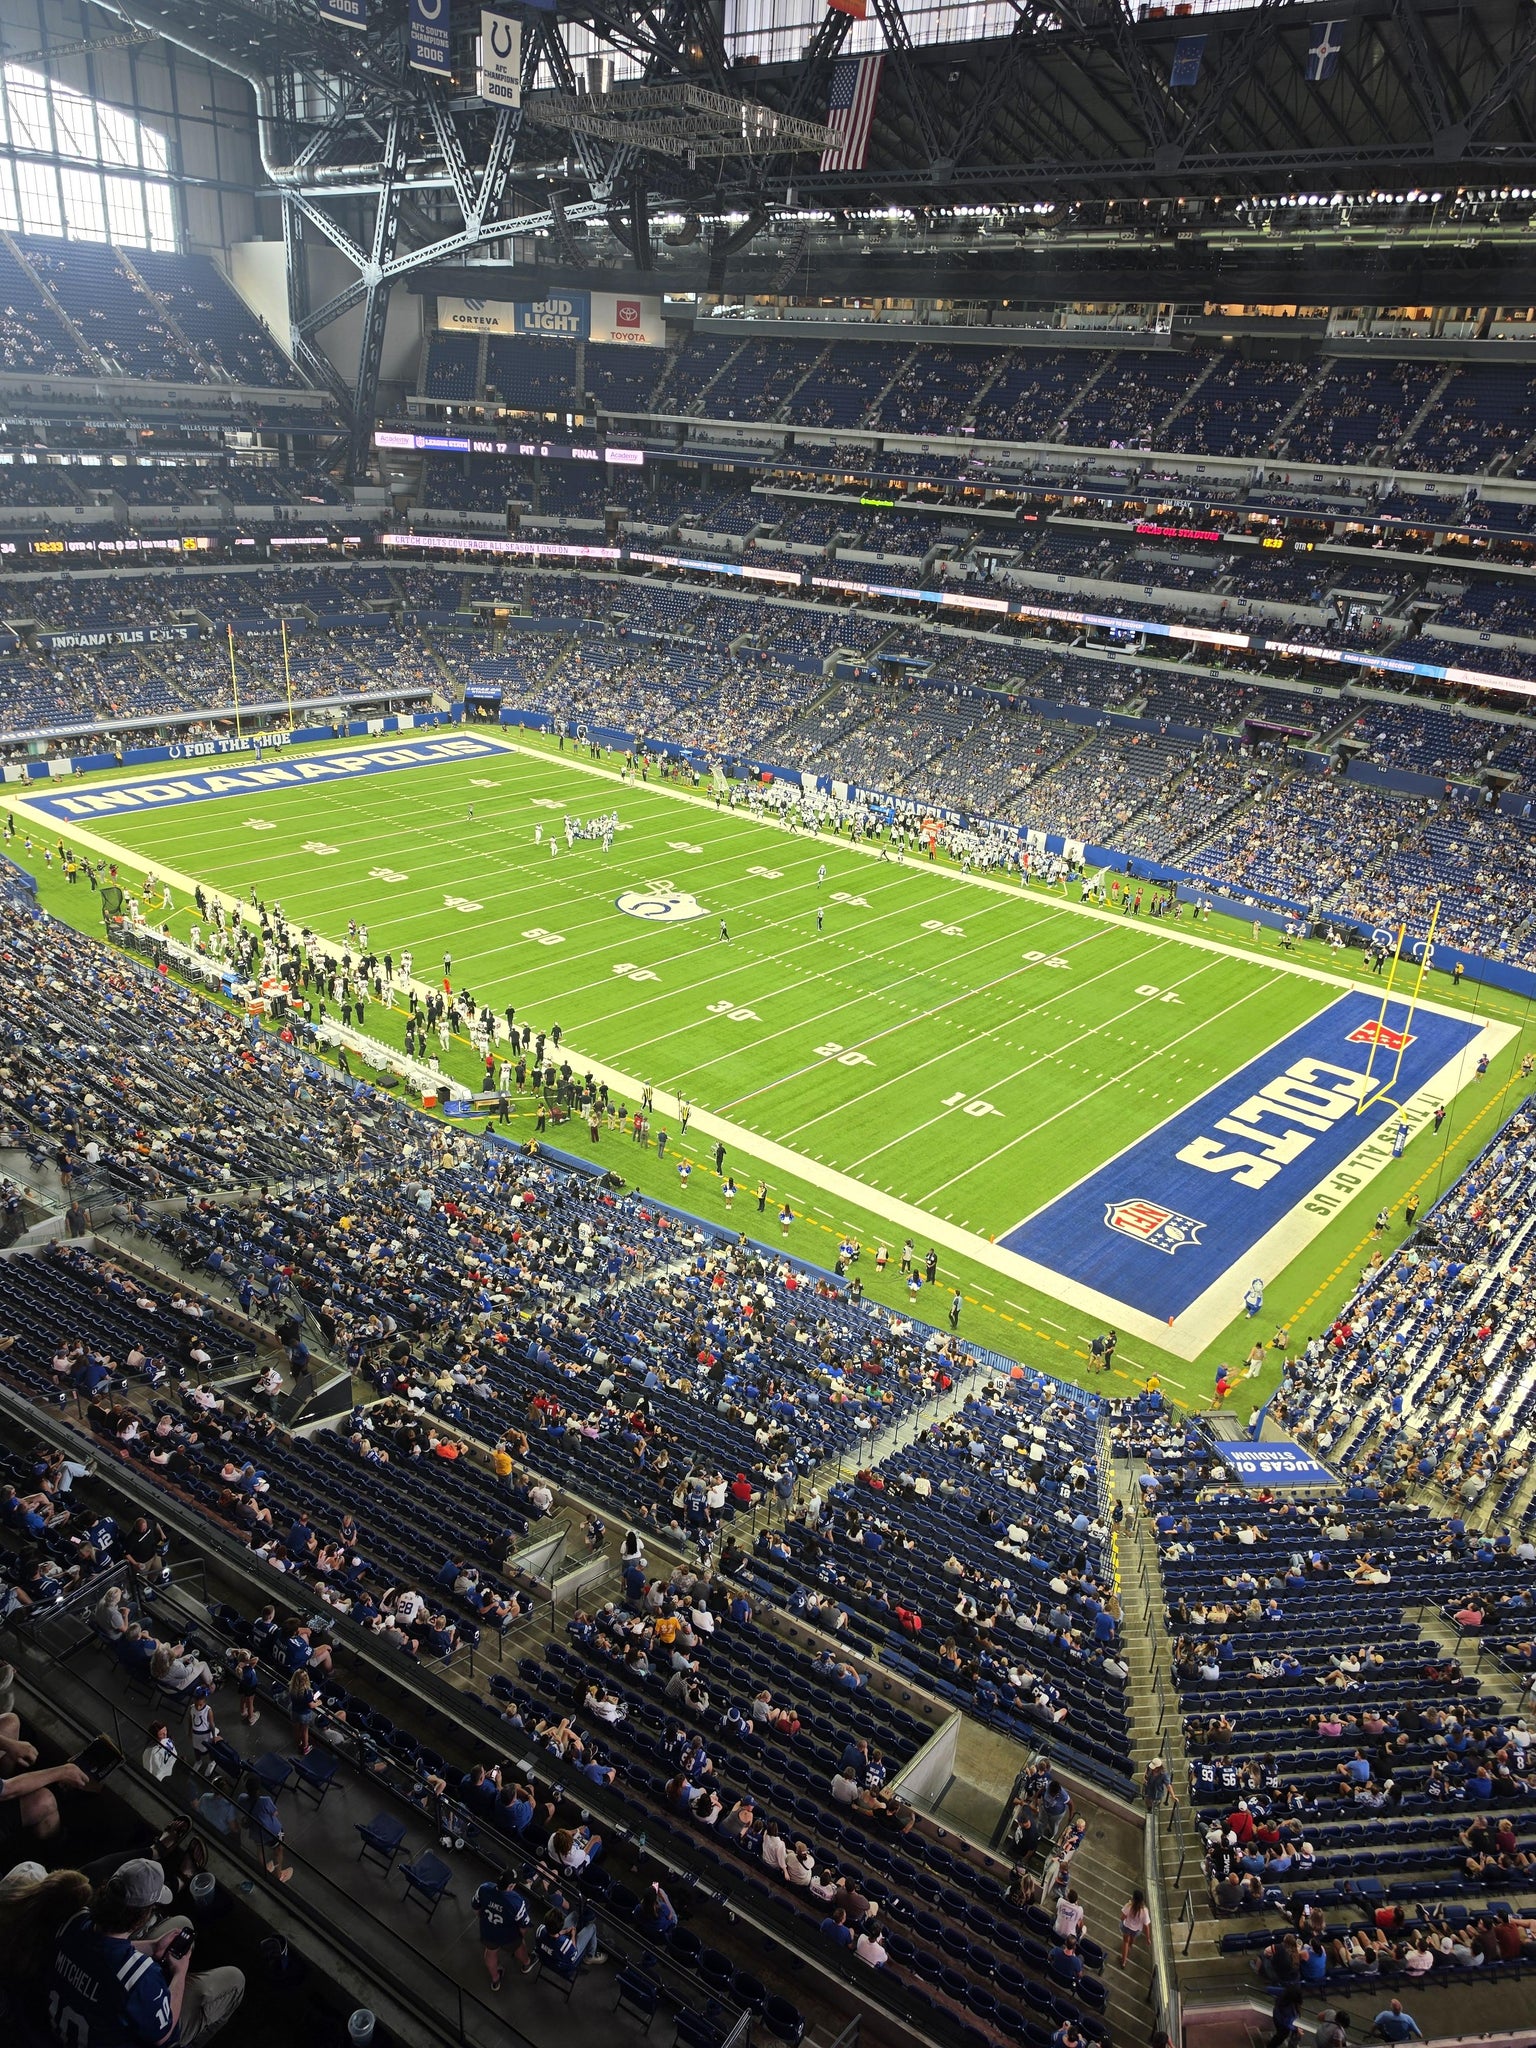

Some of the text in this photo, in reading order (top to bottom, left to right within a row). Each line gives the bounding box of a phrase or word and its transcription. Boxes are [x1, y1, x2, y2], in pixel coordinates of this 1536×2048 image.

[329, 0, 359, 15] 2005
[412, 21, 449, 39] AFC SOUTH
[411, 30, 449, 49] CHAMPIONS
[416, 45, 444, 63] 2006
[495, 64, 507, 73] AFC
[484, 69, 519, 86] CHAMPIONS
[488, 83, 513, 99] 2006
[532, 300, 572, 316] BUD
[452, 314, 499, 326] CORTEVA
[524, 313, 581, 332] LIGHT
[610, 331, 646, 343] TOYOTA
[107, 421, 127, 429] WAYNE
[202, 424, 220, 432] CLARK
[380, 435, 410, 444] Academy
[473, 441, 492, 452] NYJ
[496, 443, 507, 453] 17
[520, 445, 535, 455] PIT
[541, 446, 548, 456] 0
[572, 448, 599, 460] FINAL
[609, 451, 638, 462] Academy
[1136, 525, 1220, 541] LUCAS OIL STADIUM
[395, 536, 421, 545] CATCH
[422, 538, 447, 547] COLTS
[448, 539, 488, 549] COVERAGE
[489, 542, 503, 550] ALL
[505, 543, 535, 552] SEASON
[537, 545, 557, 553] LONG
[558, 546, 569, 554] ON
[1262, 537, 1313, 552] 13:33 QTR 4
[828, 579, 839, 588] GOT
[853, 583, 868, 592] BACK
[1021, 606, 1039, 615] WE'VE
[1040, 608, 1051, 617] GOT
[1052, 609, 1067, 620] YOUR
[1067, 611, 1083, 622] BACK
[1265, 640, 1415, 671] WE'VE GOT YOUR BACK FROM KICKOFF TO RECOVERY
[40, 725, 94, 735] STADIUM
[185, 742, 216, 757] FOR
[219, 738, 250, 752] THE
[54, 738, 493, 815] INDIANAPOLIS
[855, 788, 961, 826] INDIANAPOLIS
[368, 867, 408, 883] 30
[746, 866, 784, 880] 50
[443, 896, 484, 912] 40
[920, 920, 963, 936] 30
[521, 928, 566, 945] 50
[1022, 951, 1069, 968] 20
[612, 963, 656, 982] 40
[1135, 985, 1179, 1003] 10
[706, 1000, 756, 1022] 30
[813, 1042, 867, 1066] 20
[941, 1092, 995, 1117] 10
[1417, 1092, 1444, 1108] IT
[1175, 1057, 1381, 1190] COLTS
[1348, 1144, 1390, 1170] ALL
[1330, 1172, 1362, 1194] OF
[1304, 1193, 1342, 1217] US
[1114, 1203, 1169, 1235] NFL
[1231, 1451, 1297, 1461] STADIUM
[1261, 1460, 1319, 1473] LUCAS
[1060, 1483, 1071, 1498] 18
[692, 1502, 700, 1512] 5
[98, 1532, 114, 1551] 12
[399, 1601, 413, 1616] 28
[1516, 1755, 1524, 1769] 8
[1201, 1769, 1214, 1782] 93
[1222, 1773, 1236, 1787] 56
[1222, 1854, 1231, 1875] GMC
[488, 1900, 504, 1914] JAMES
[54, 1950, 104, 2003] MITCHELL
